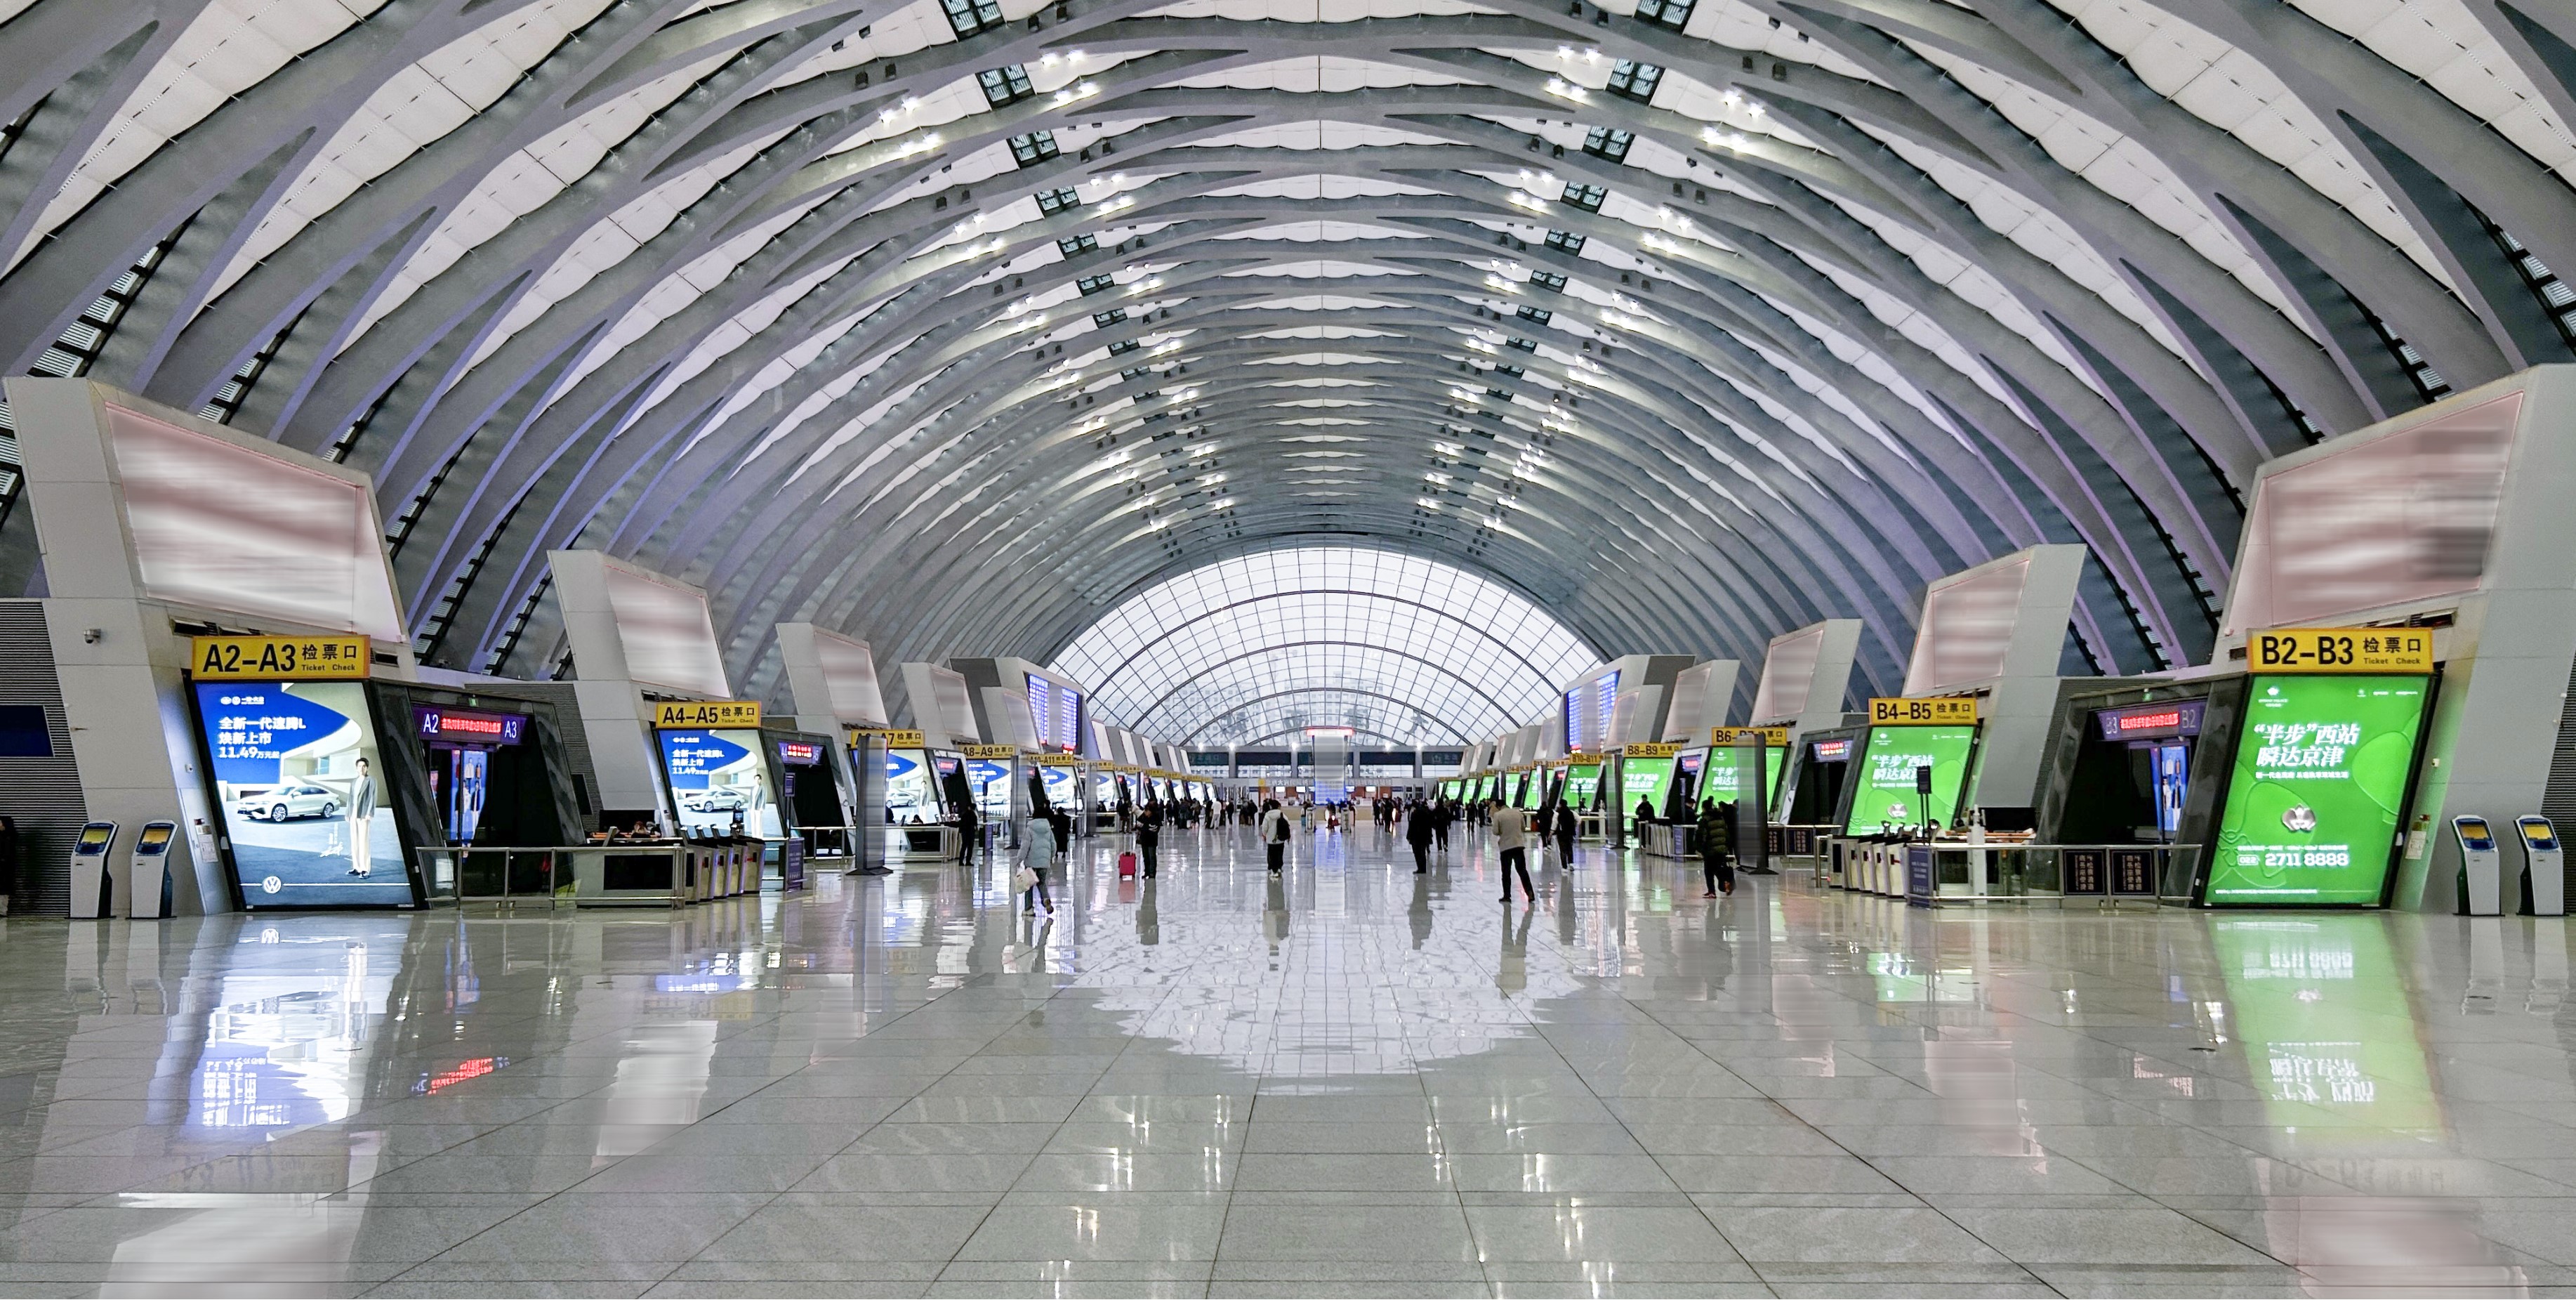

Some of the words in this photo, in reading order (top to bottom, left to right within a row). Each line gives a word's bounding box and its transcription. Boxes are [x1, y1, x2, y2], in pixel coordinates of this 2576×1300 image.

[302, 644, 357, 660] 检票口
[2261, 636, 2353, 665] B2-B3
[2363, 636, 2421, 653] 检票口
[202, 643, 296, 673] A2-A3
[663, 707, 718, 724] A4-A5
[721, 707, 755, 716] 检票口
[1877, 702, 1931, 720] B4-B5
[1936, 703, 1970, 713] 检票口
[423, 714, 439, 733] A2
[2106, 717, 2118, 734] B3
[2181, 709, 2196, 728] B2
[218, 732, 272, 744] 焕新上市
[504, 721, 517, 738] A3
[963, 747, 993, 756] A8-A9
[1627, 745, 1658, 755] B8-B9
[2255, 745, 2345, 767] 瞬达京津
[2265, 853, 2301, 867] 2711
[2304, 853, 2349, 867] 8888
